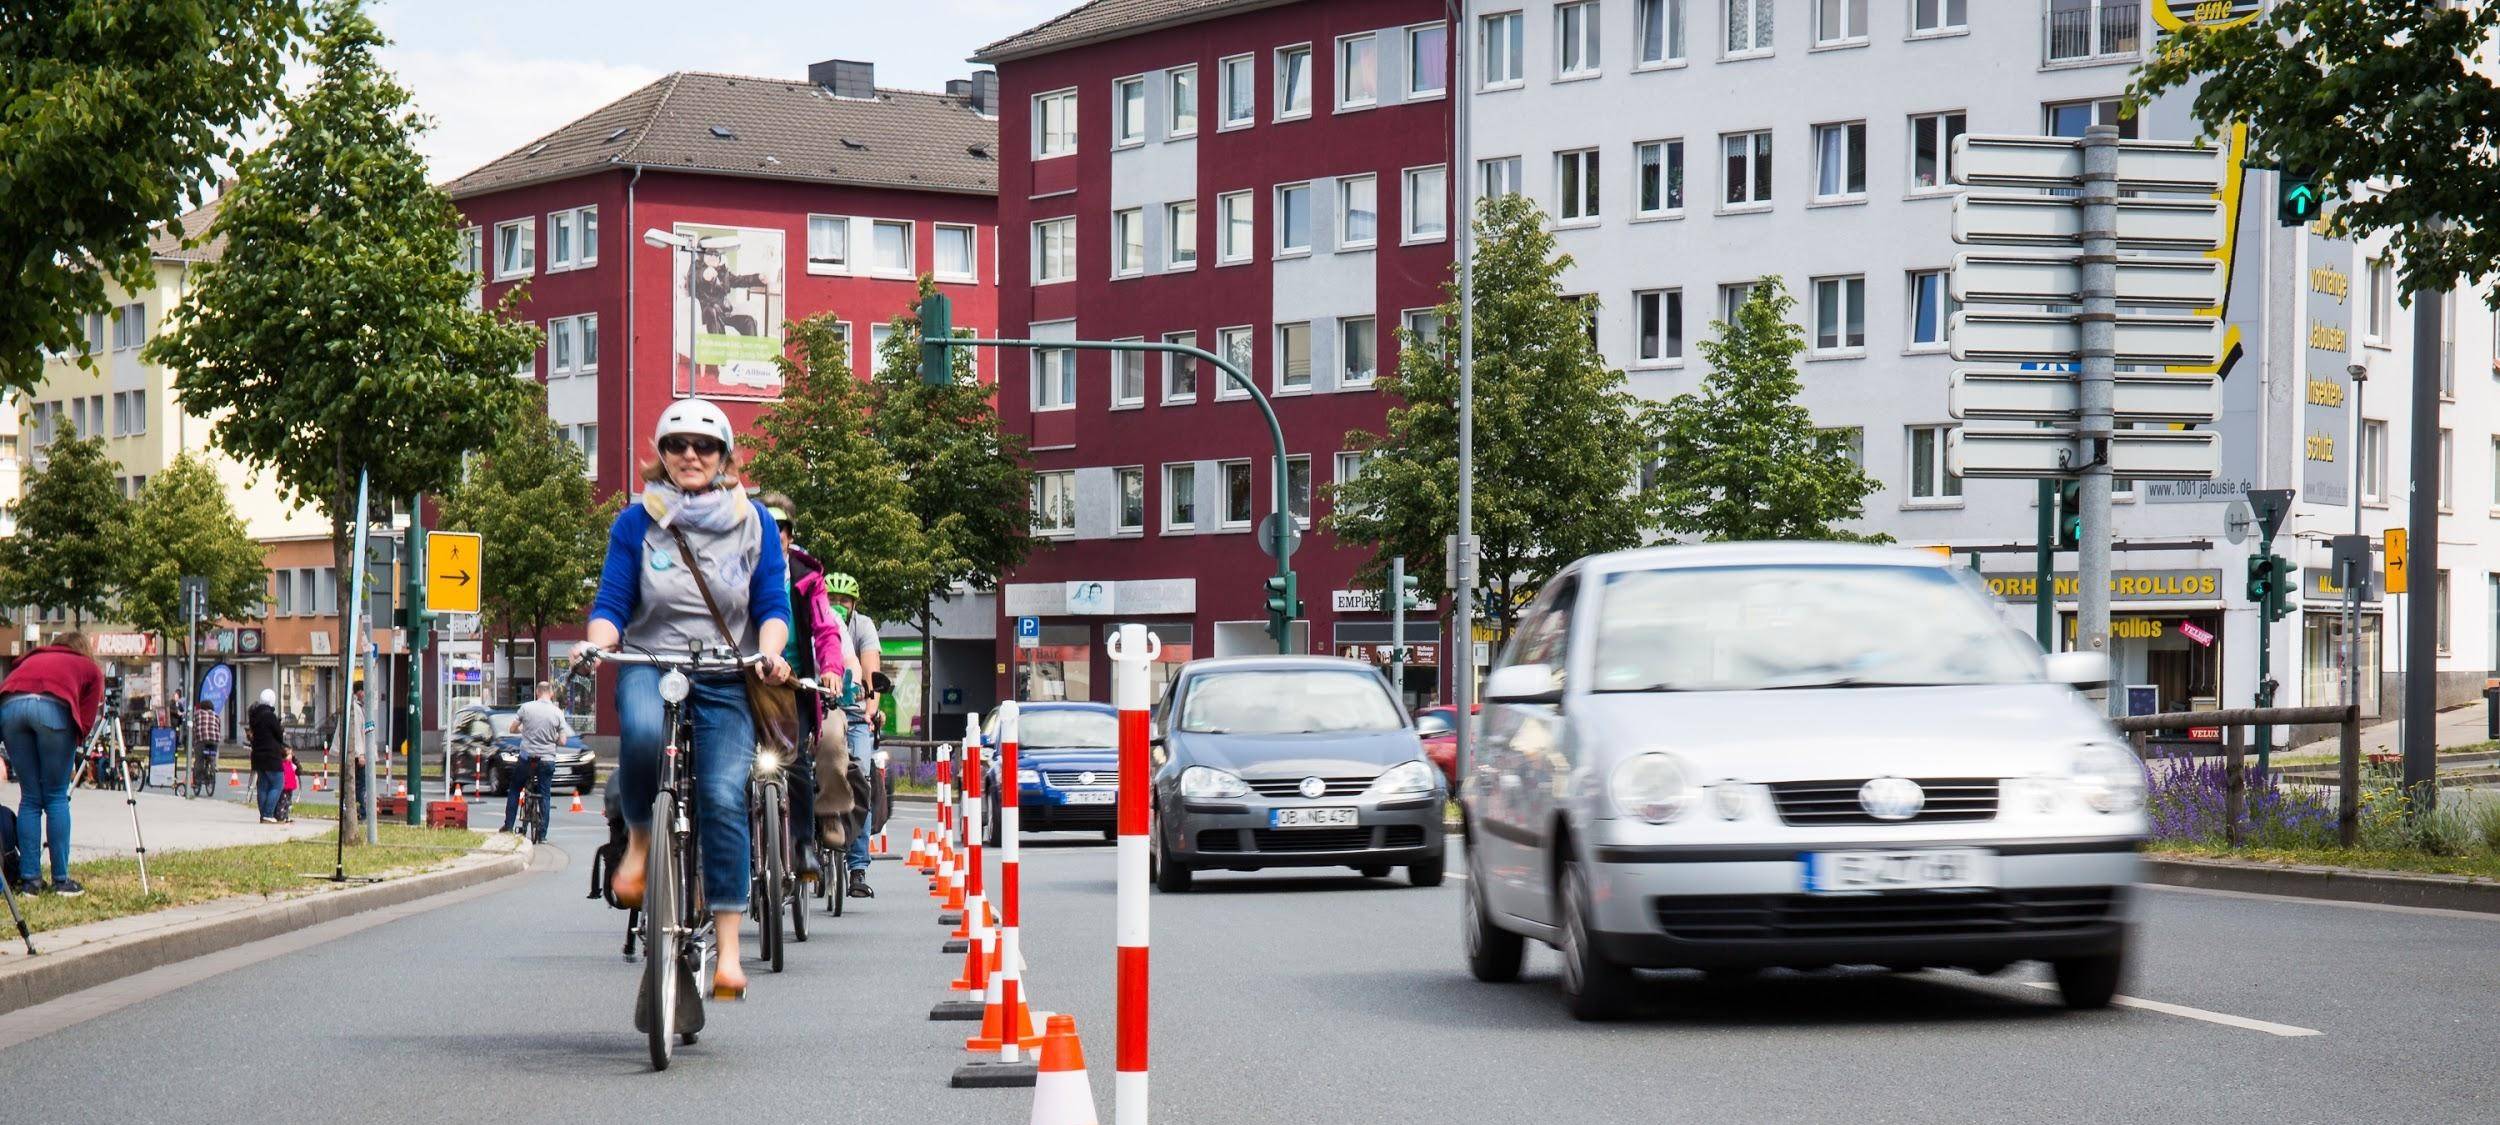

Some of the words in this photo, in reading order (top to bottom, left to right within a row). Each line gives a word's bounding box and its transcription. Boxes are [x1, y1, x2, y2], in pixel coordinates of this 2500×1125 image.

[2307, 427, 2334, 463] schutz
[1023, 618, 1035, 635] P
[2191, 729, 2219, 738] VELUX
